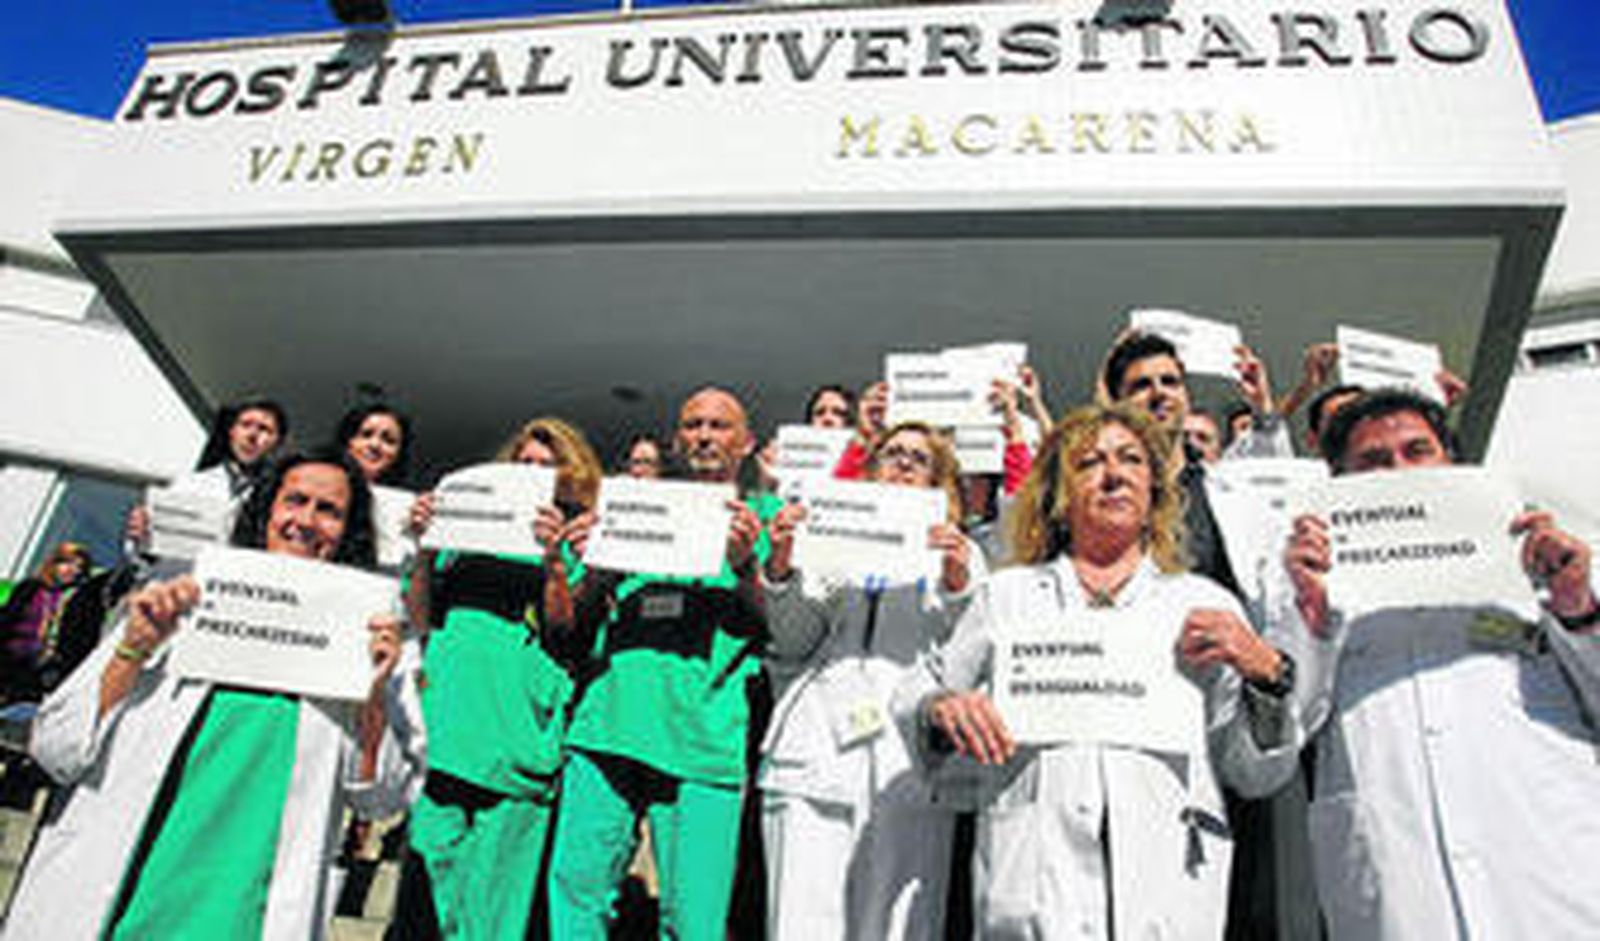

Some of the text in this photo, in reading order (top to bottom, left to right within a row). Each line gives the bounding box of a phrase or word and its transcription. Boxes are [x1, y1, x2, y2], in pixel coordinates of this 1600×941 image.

[123, 9, 1490, 121] HOSPITAL UNIVERSITARIO
[246, 109, 1276, 182] VIRGEN MACARENA
[1331, 503, 1427, 526] EVENTUAL
[1337, 539, 1477, 565] PRECARIEDAD
[206, 577, 299, 605] EVENTUAL
[1011, 641, 1104, 659] EVENTUAL
[1010, 678, 1147, 698] DESIGUALDAD
